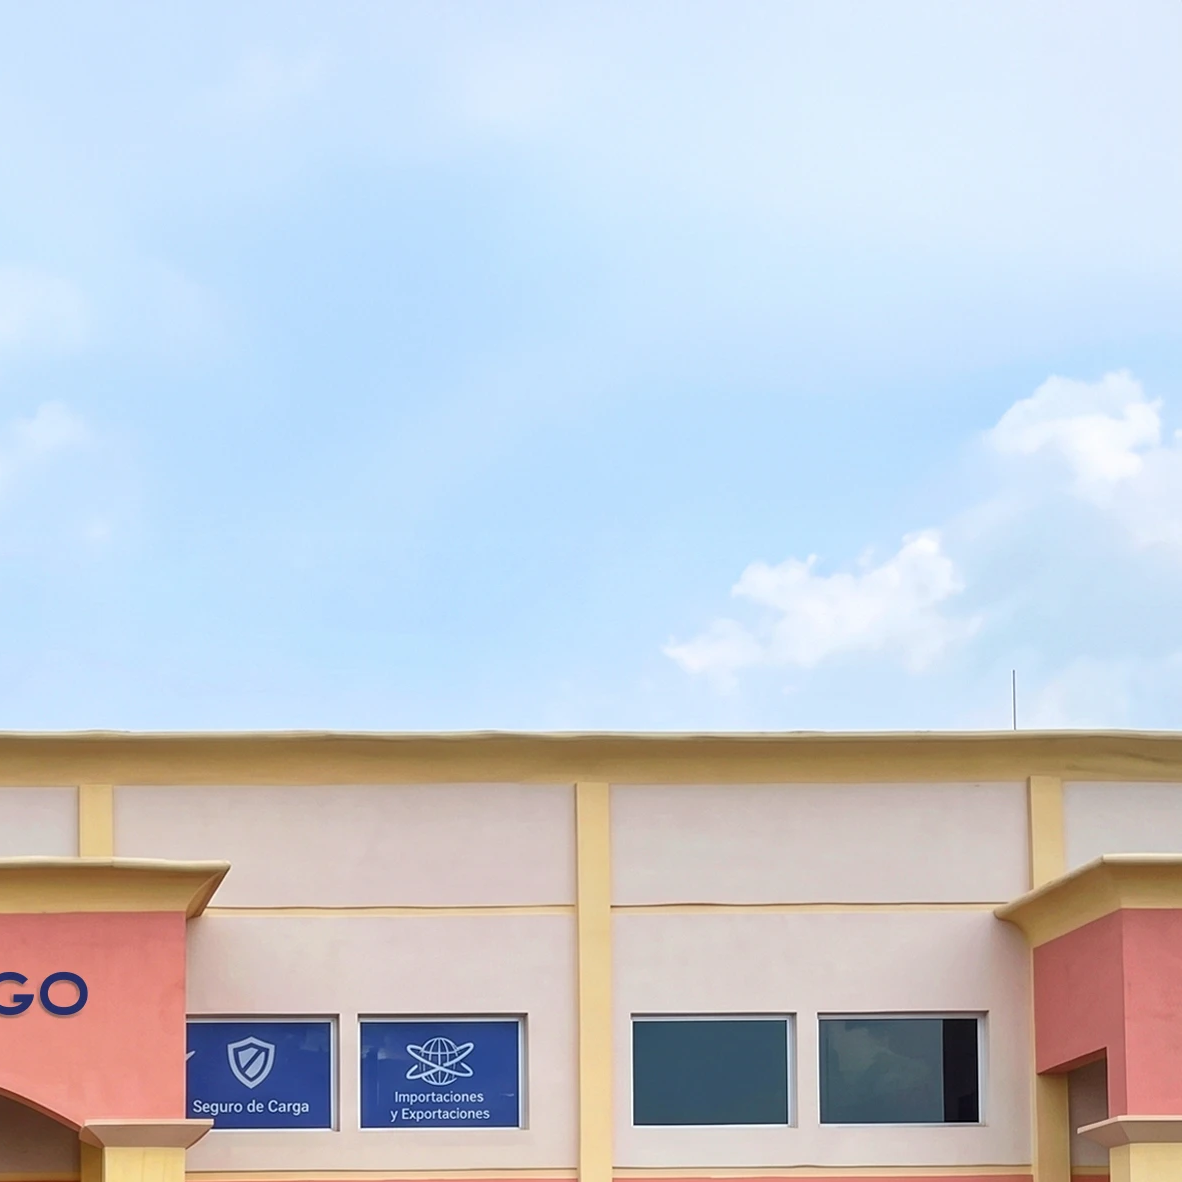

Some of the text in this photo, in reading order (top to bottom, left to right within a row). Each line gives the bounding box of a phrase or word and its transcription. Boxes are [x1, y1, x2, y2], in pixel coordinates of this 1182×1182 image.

[394, 1091, 484, 1106] Importaciones
[192, 1100, 310, 1117] Seguro de Carga
[390, 1107, 490, 1122] y Exportaciones
